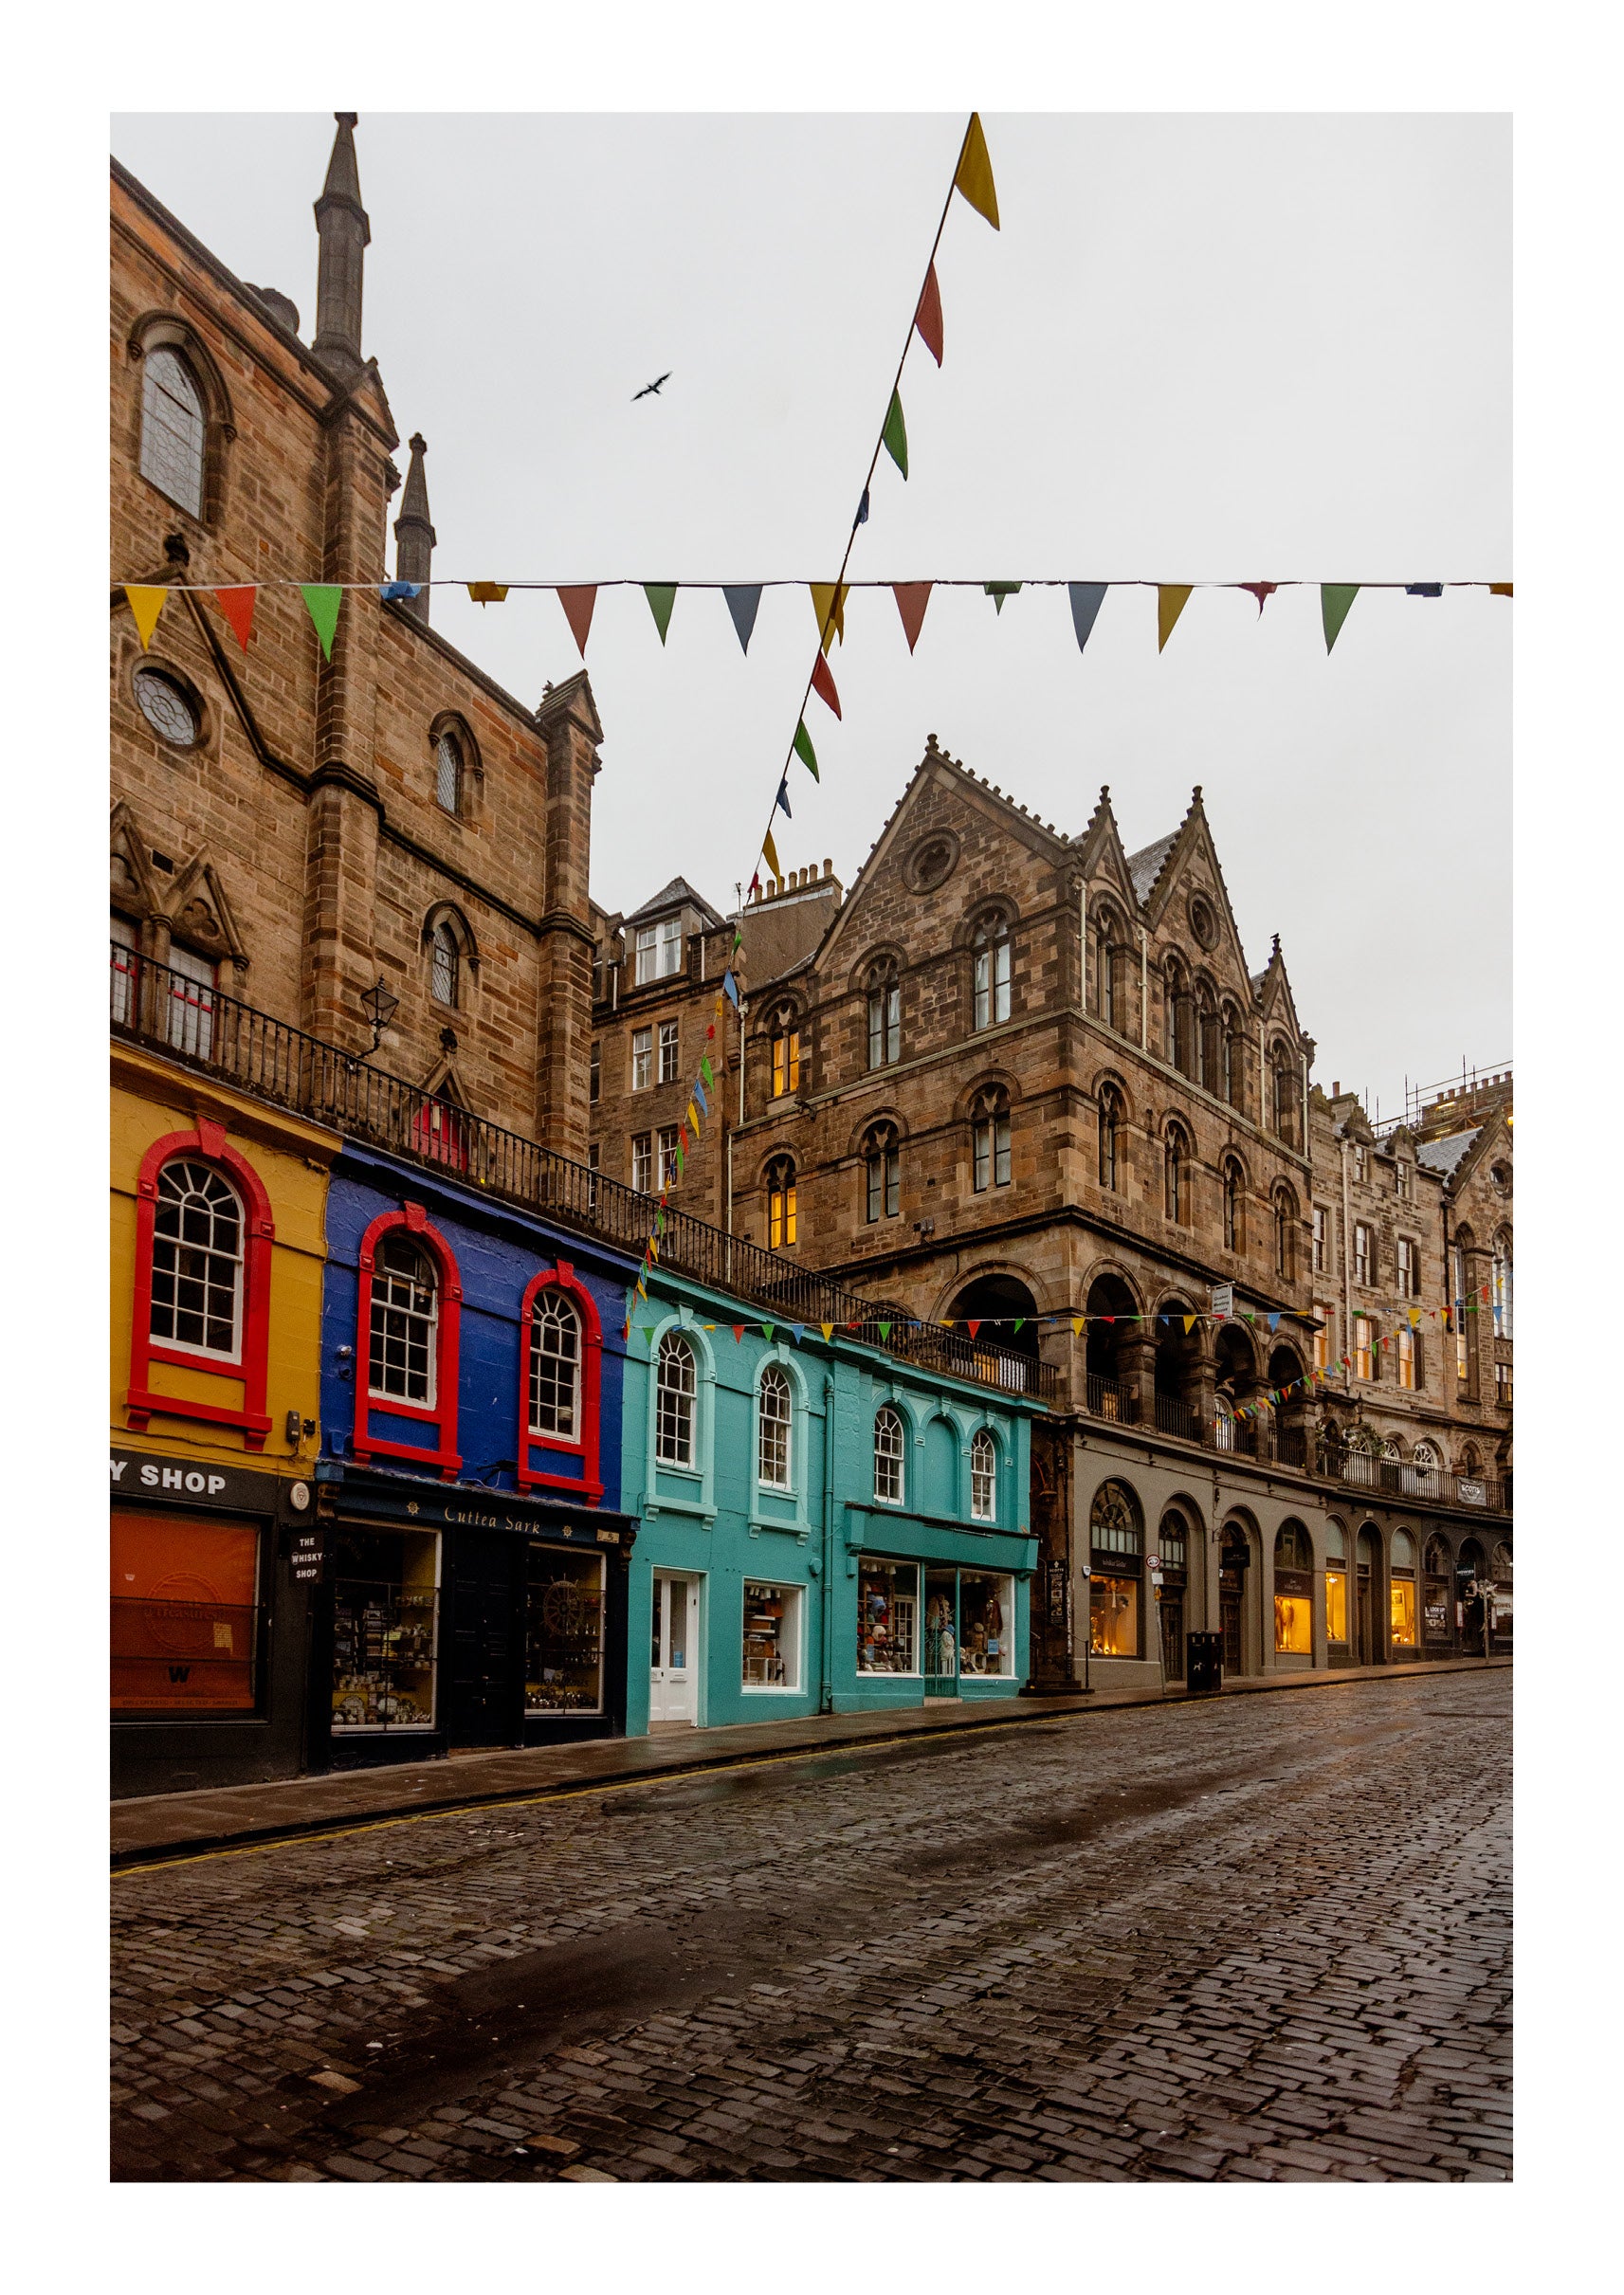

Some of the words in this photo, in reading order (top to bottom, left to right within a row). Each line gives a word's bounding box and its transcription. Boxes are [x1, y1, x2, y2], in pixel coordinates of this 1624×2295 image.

[110, 1460, 127, 1481] Y
[140, 1465, 226, 1494] SHOP
[444, 1505, 497, 1528] Cuttea
[505, 1515, 540, 1534] Sark
[299, 1538, 316, 1547] THE
[291, 1552, 323, 1565] WHISKY
[296, 1569, 318, 1578] SHOP
[168, 1666, 191, 1684] W
